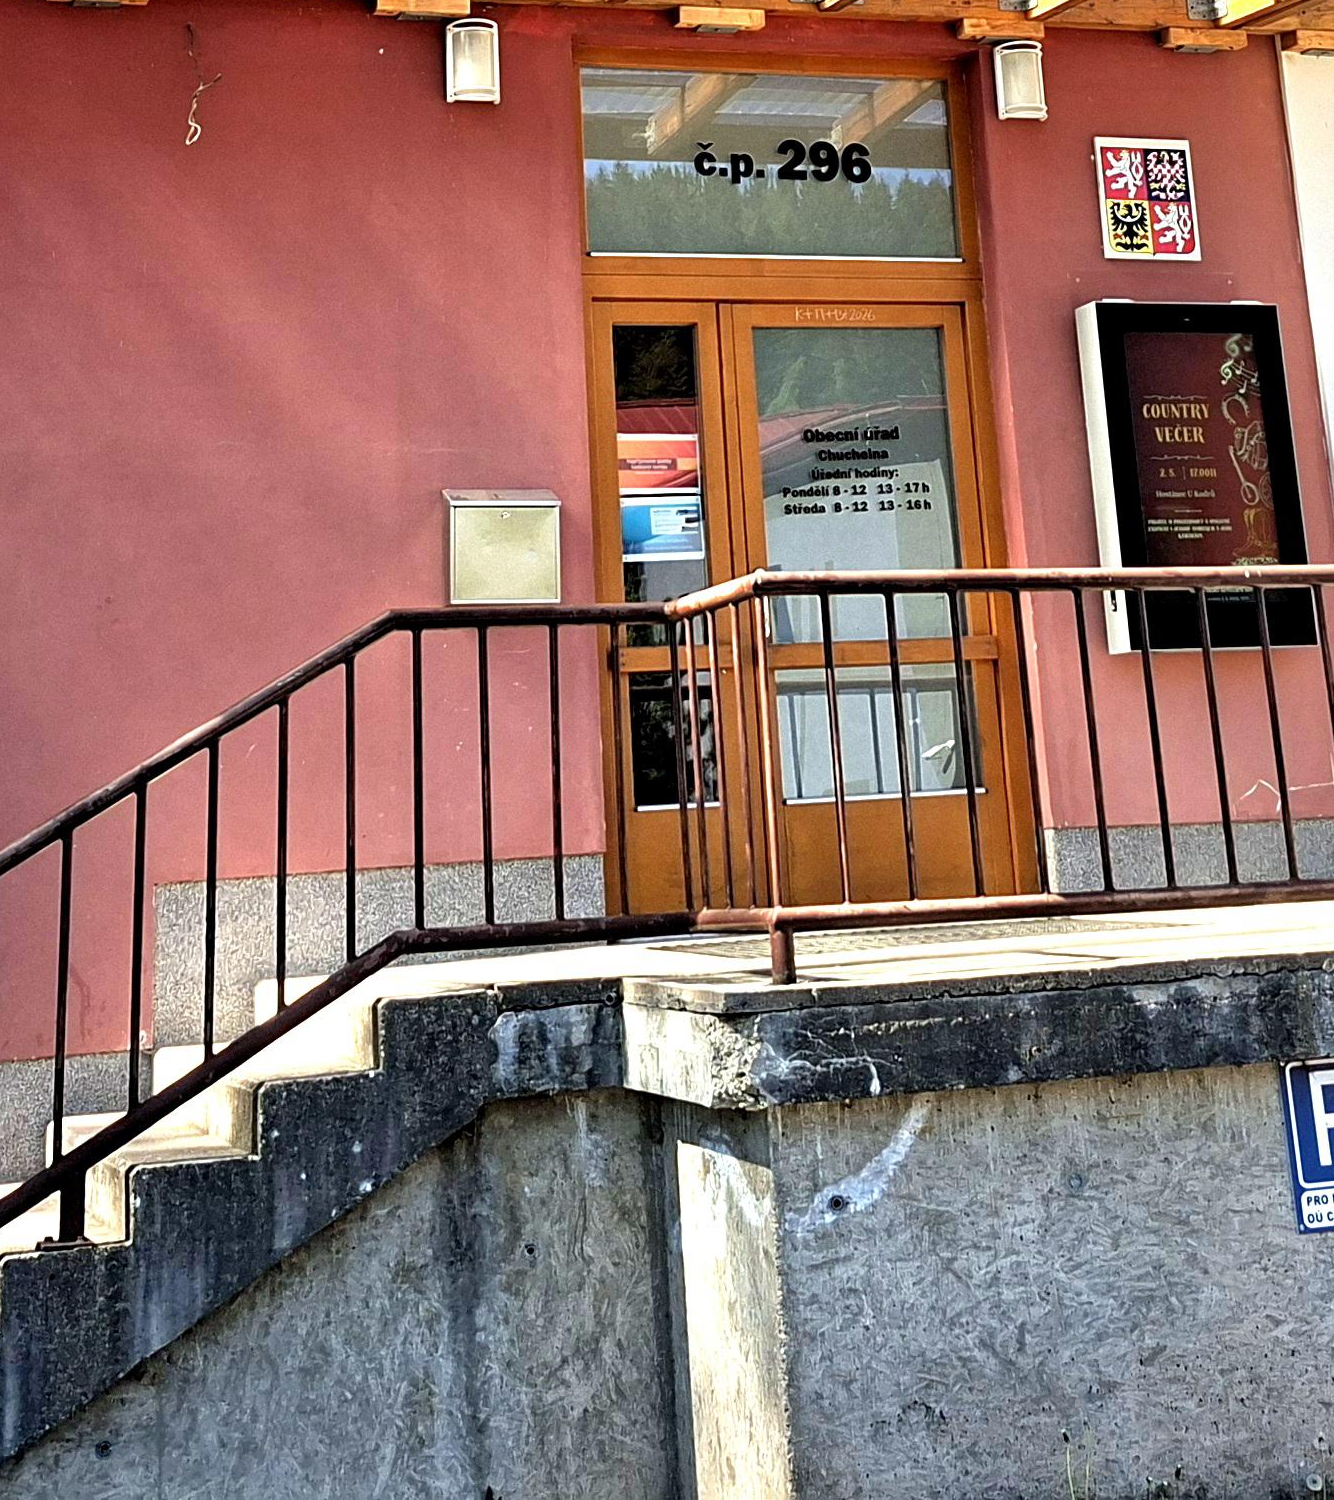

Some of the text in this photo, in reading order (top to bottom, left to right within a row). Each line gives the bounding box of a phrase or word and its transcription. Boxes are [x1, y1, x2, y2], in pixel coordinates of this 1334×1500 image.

[693, 138, 872, 184] č.p. 296
[1142, 403, 1210, 420] COUNTRY
[803, 426, 900, 442] Obecní úřad
[1154, 424, 1205, 444] VEČER
[818, 448, 889, 461] Chuchelna
[811, 467, 899, 480] Úřední hodiny:
[782, 486, 829, 498] Pondělí
[833, 485, 841, 496] 8
[851, 485, 867, 495] 12
[877, 483, 893, 494] 13
[904, 482, 920, 493] 17
[784, 502, 826, 515] Středa
[834, 502, 841, 512] 8
[852, 501, 868, 512] 12
[879, 500, 895, 511] 13
[906, 499, 922, 510] 16
[1307, 1194, 1328, 1206] PRO
[1307, 1209, 1323, 1223] OÚ
